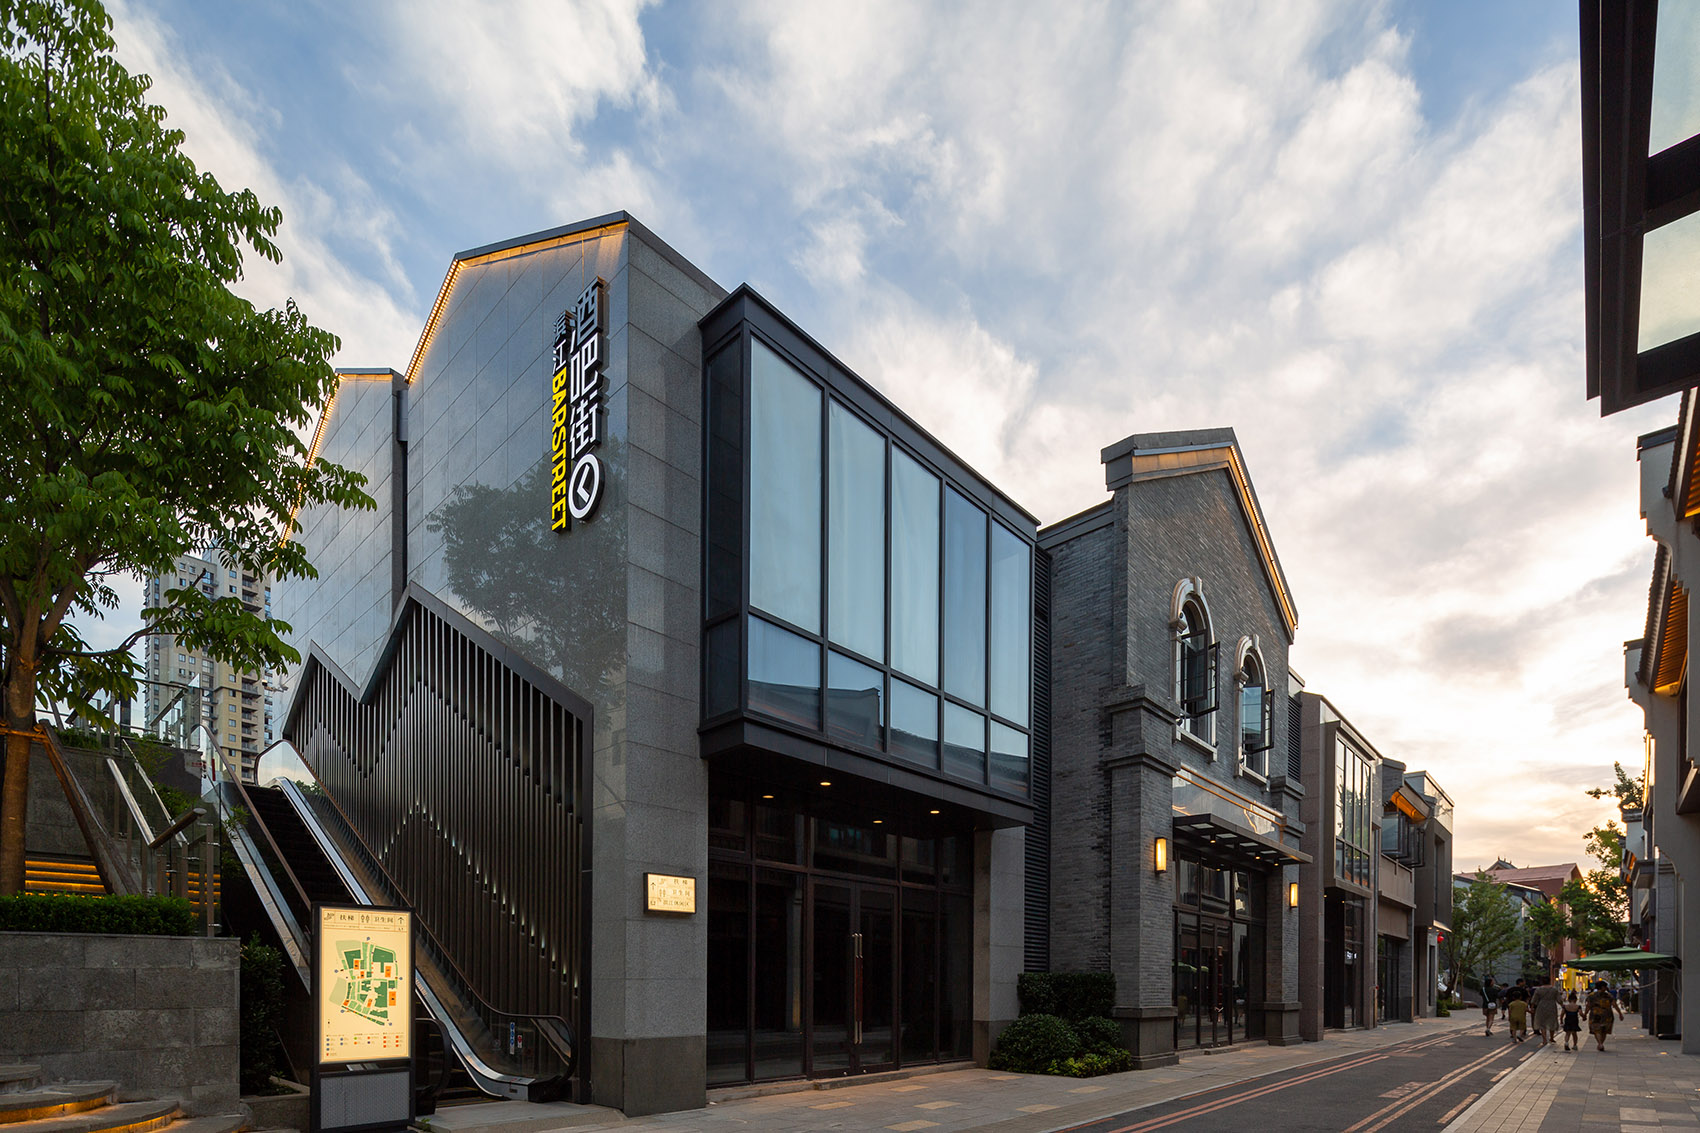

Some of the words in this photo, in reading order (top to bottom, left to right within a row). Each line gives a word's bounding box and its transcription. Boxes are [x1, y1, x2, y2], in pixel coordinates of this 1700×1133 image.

[551, 366, 567, 531] BARSTREET
[570, 276, 600, 459] 酒吧街
